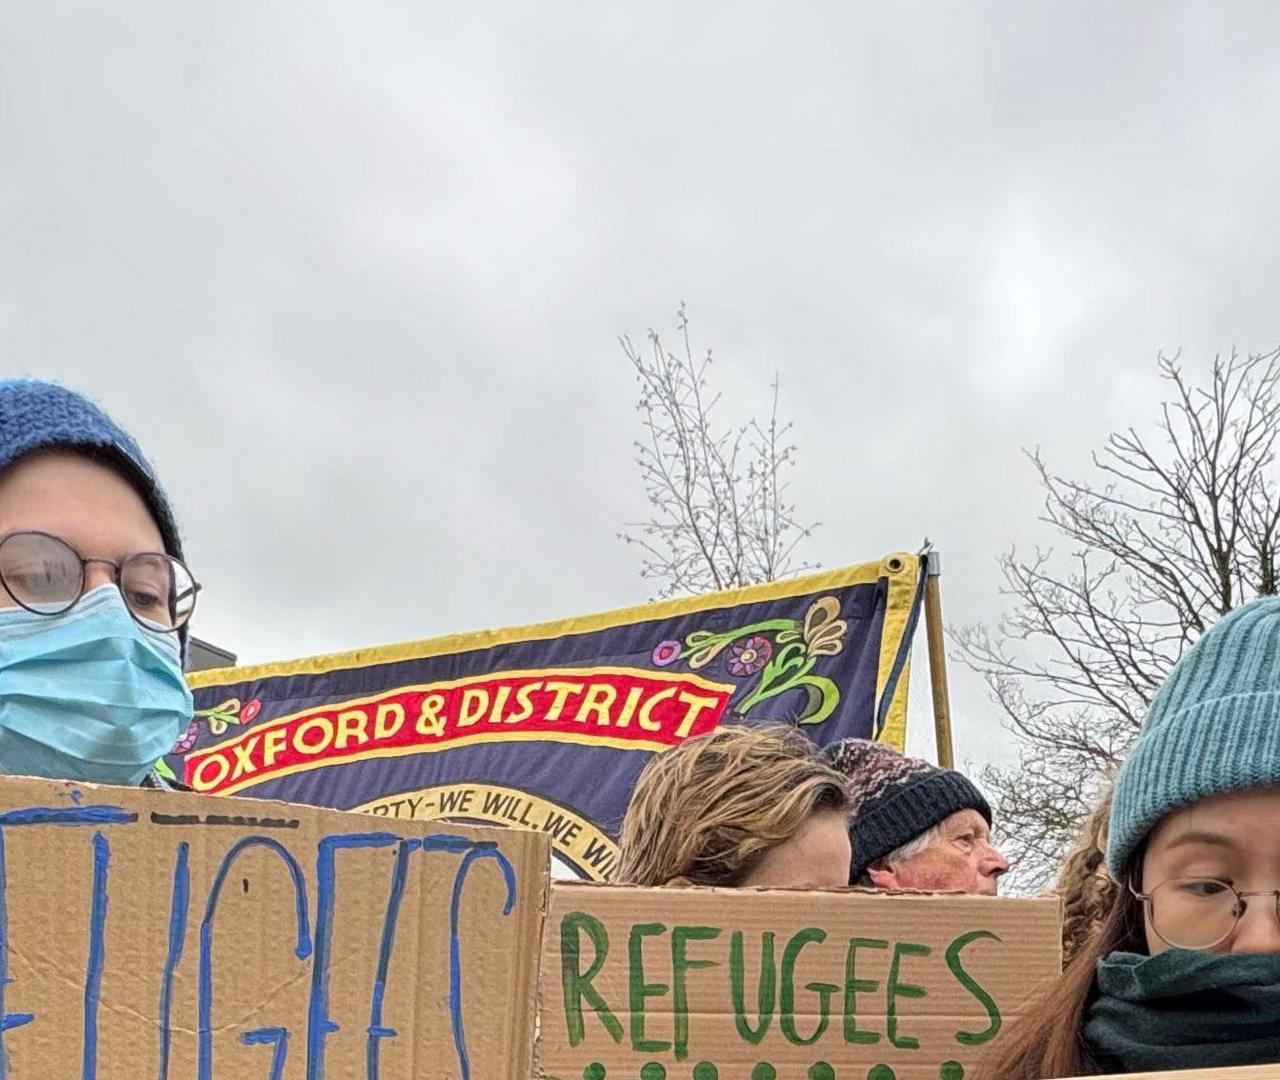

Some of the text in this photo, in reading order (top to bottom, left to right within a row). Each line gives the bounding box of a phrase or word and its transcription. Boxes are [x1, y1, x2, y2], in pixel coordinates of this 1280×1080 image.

[192, 681, 719, 791] OXFORD & DISTRICT
[542, 811, 582, 847] WE
[560, 911, 1002, 1060] REFUGEES
